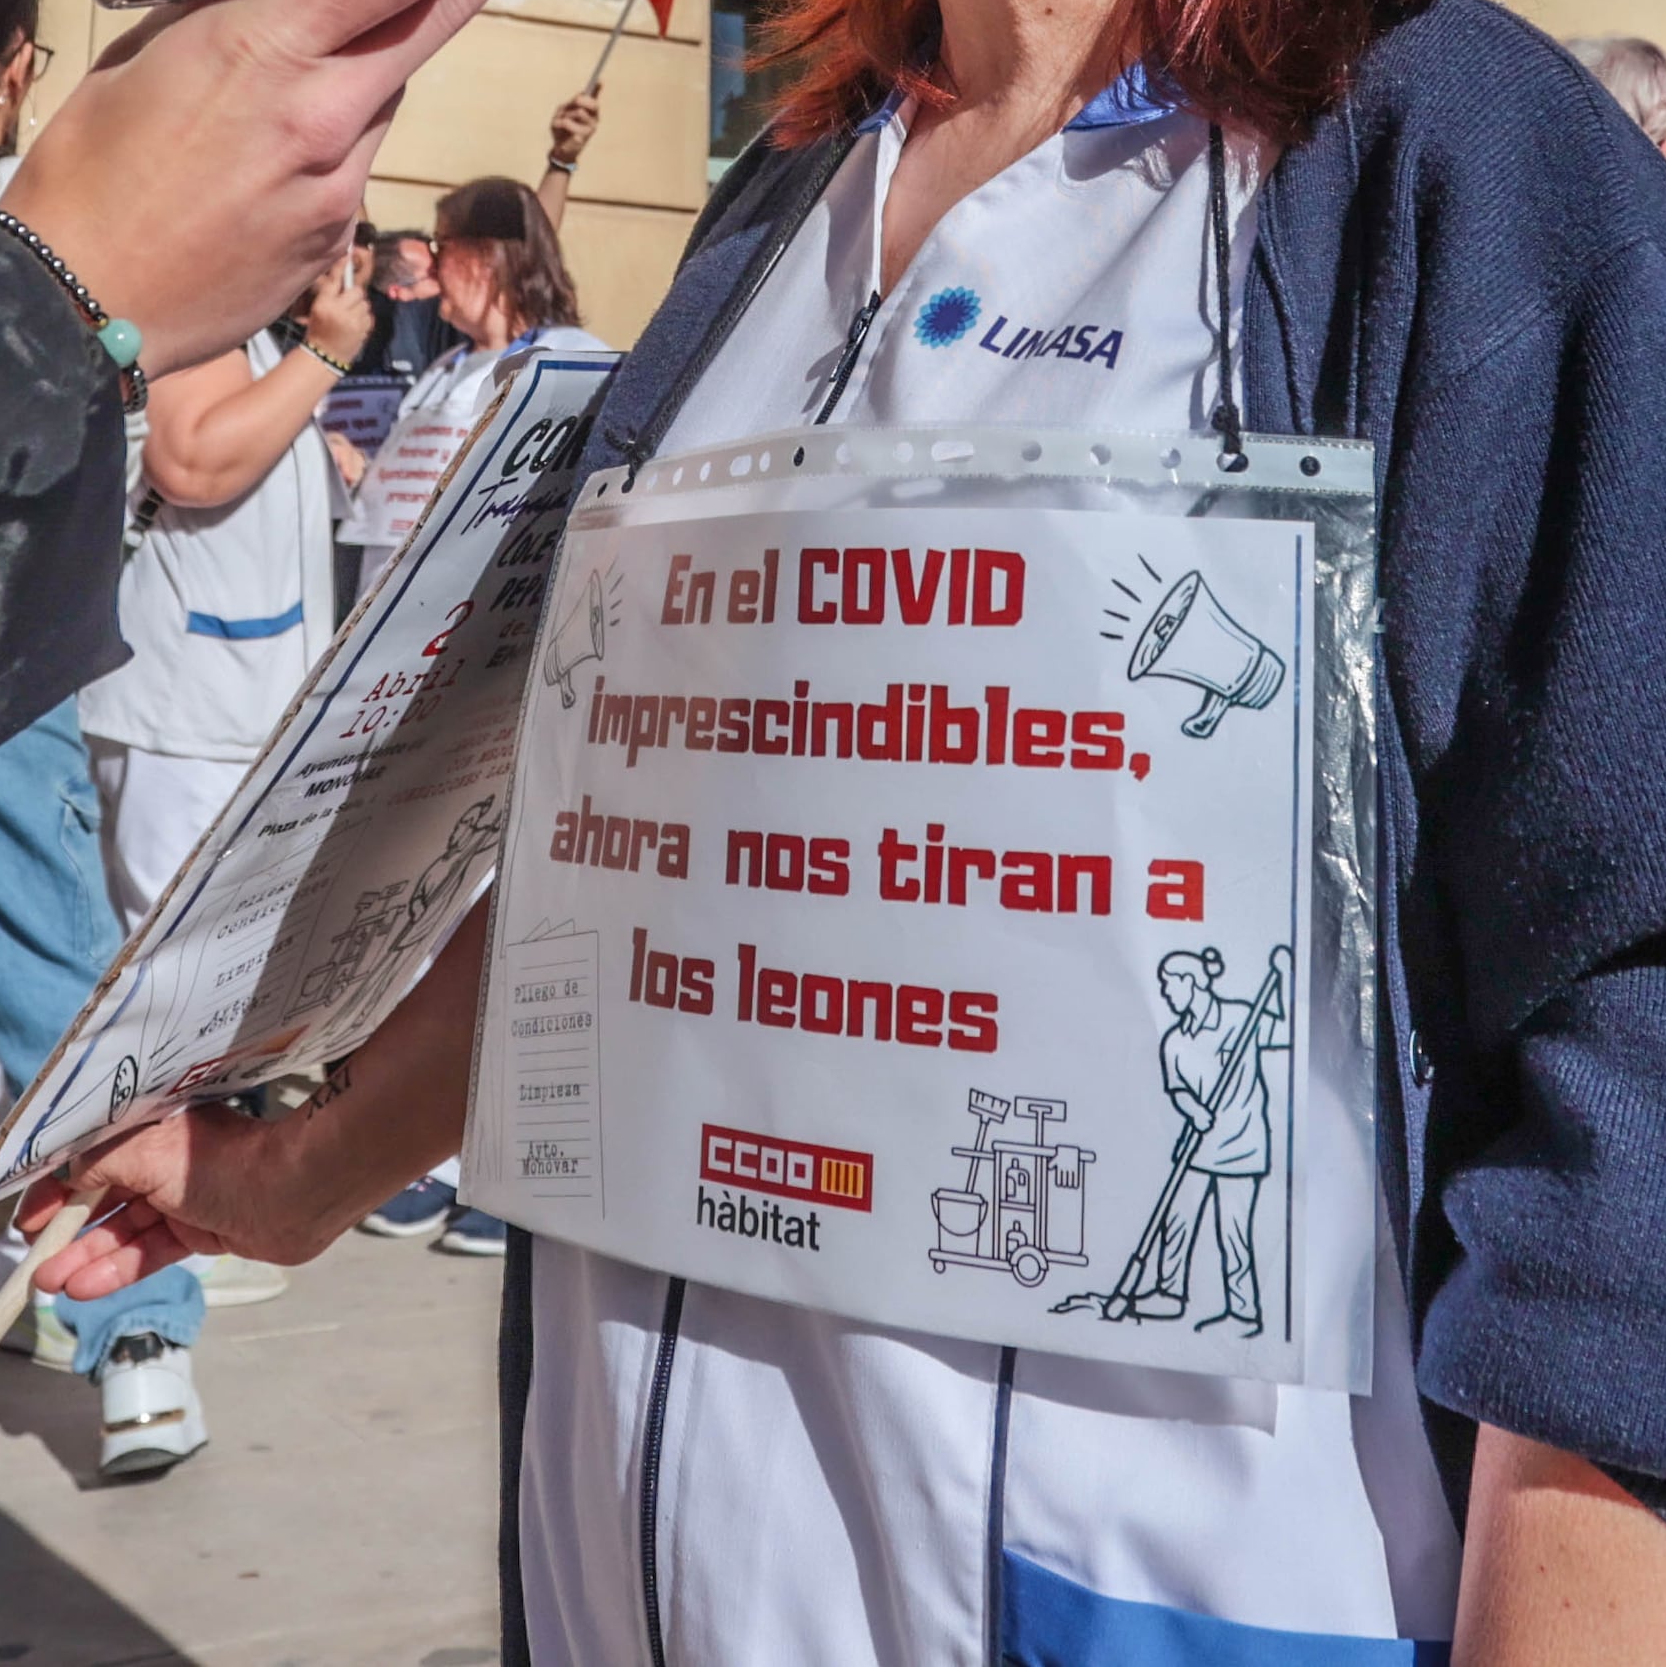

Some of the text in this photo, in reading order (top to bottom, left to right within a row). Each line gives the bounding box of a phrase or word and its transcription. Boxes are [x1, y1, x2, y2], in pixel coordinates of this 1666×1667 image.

[978, 315, 1124, 370] LIMASA
[659, 548, 1026, 626] En el COVID
[421, 600, 475, 657] 2
[361, 658, 465, 704] Abril
[339, 695, 442, 739] 10:00
[588, 676, 1151, 782] imprescindibles,
[549, 795, 1204, 922] ahora nos tiran a
[629, 928, 998, 1054] los leones
[707, 1135, 814, 1190] CCOO
[696, 1185, 821, 1252] hàbitat
